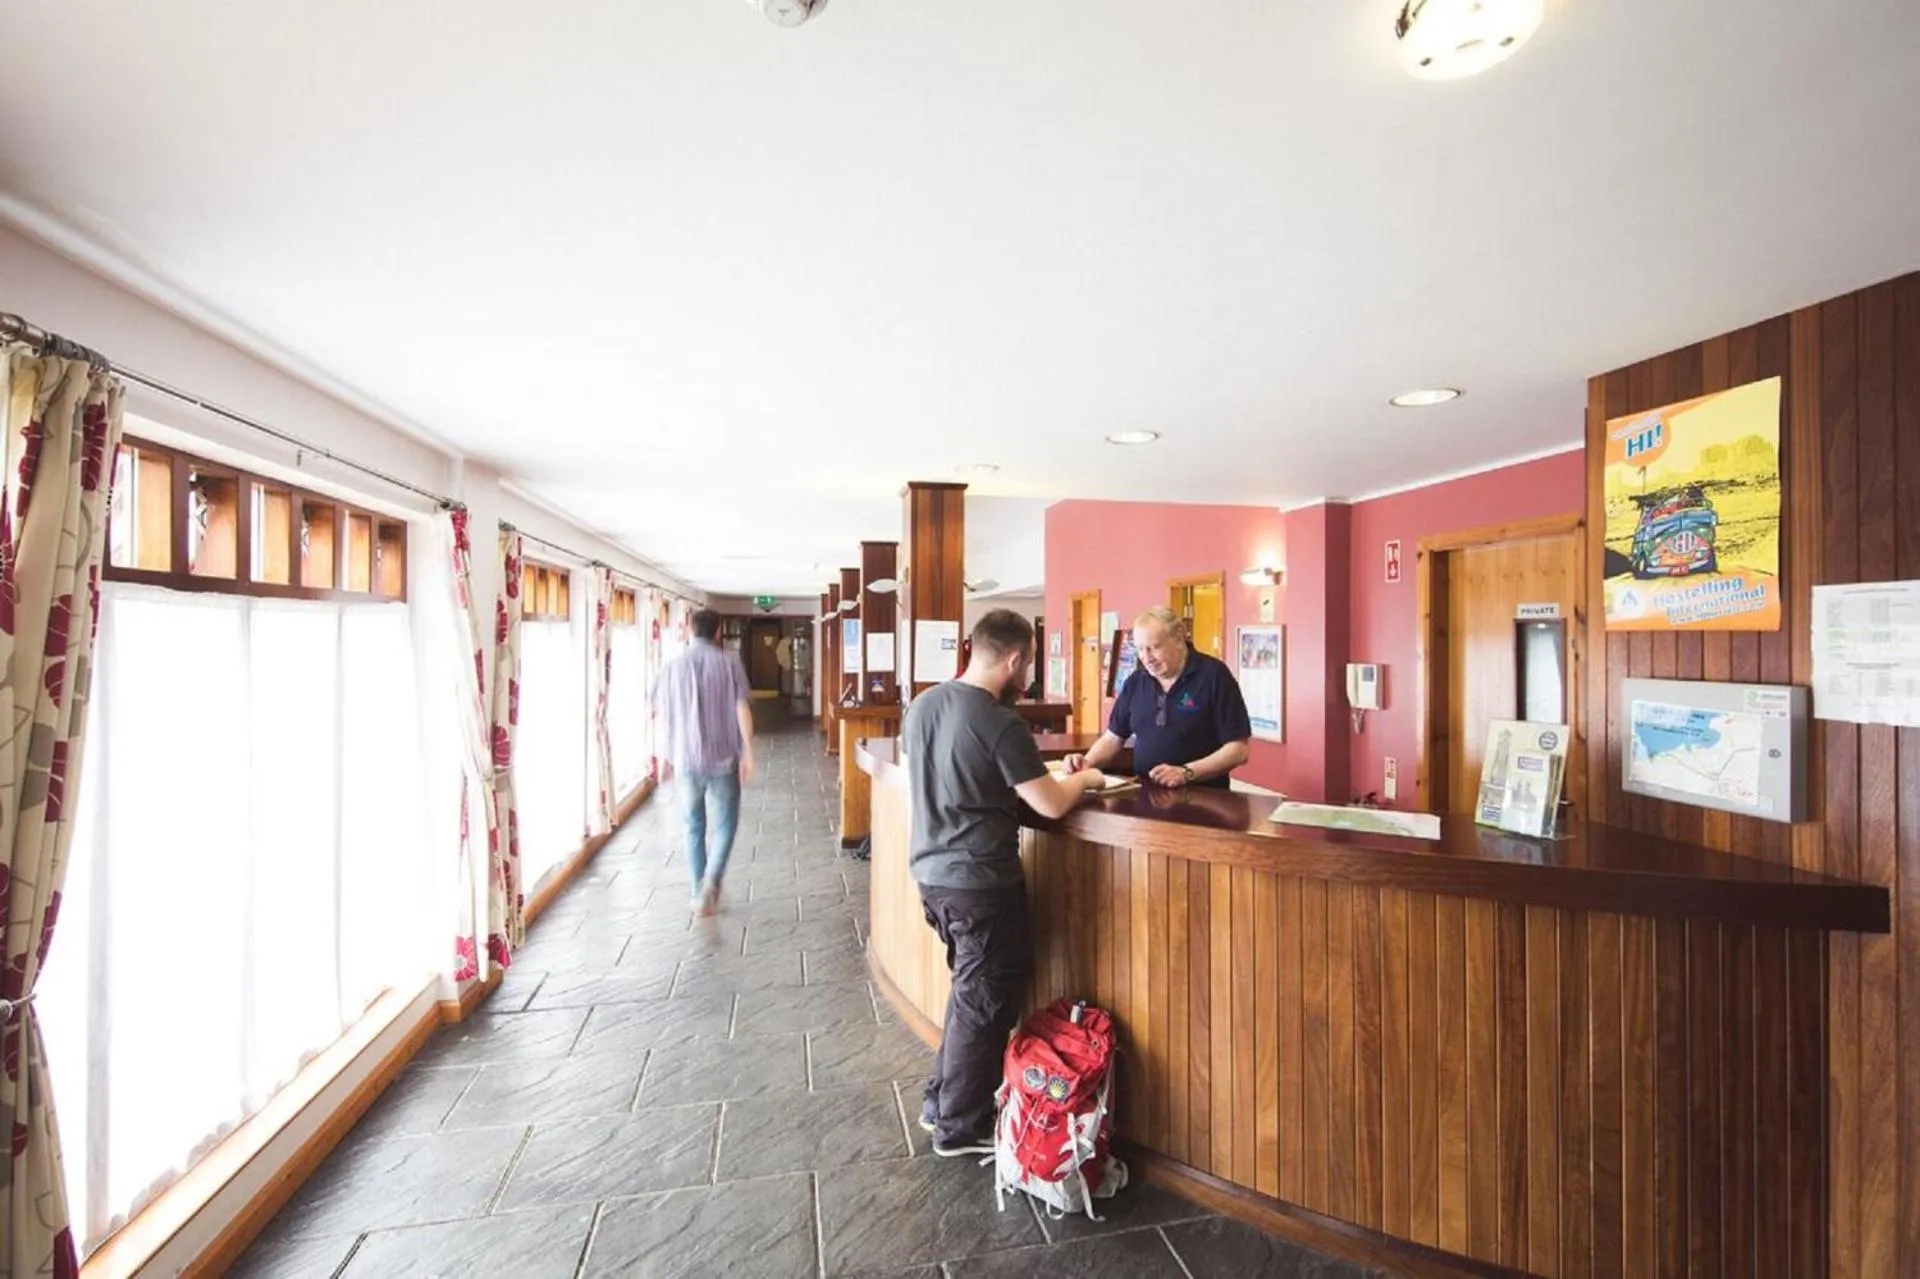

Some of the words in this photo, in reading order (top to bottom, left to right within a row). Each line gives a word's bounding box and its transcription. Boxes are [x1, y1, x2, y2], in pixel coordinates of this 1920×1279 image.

[1627, 424, 1662, 457] HI!
[1654, 577, 1743, 606] Hostelling
[1666, 584, 1765, 617] International
[1521, 606, 1555, 616] PRIVATE
